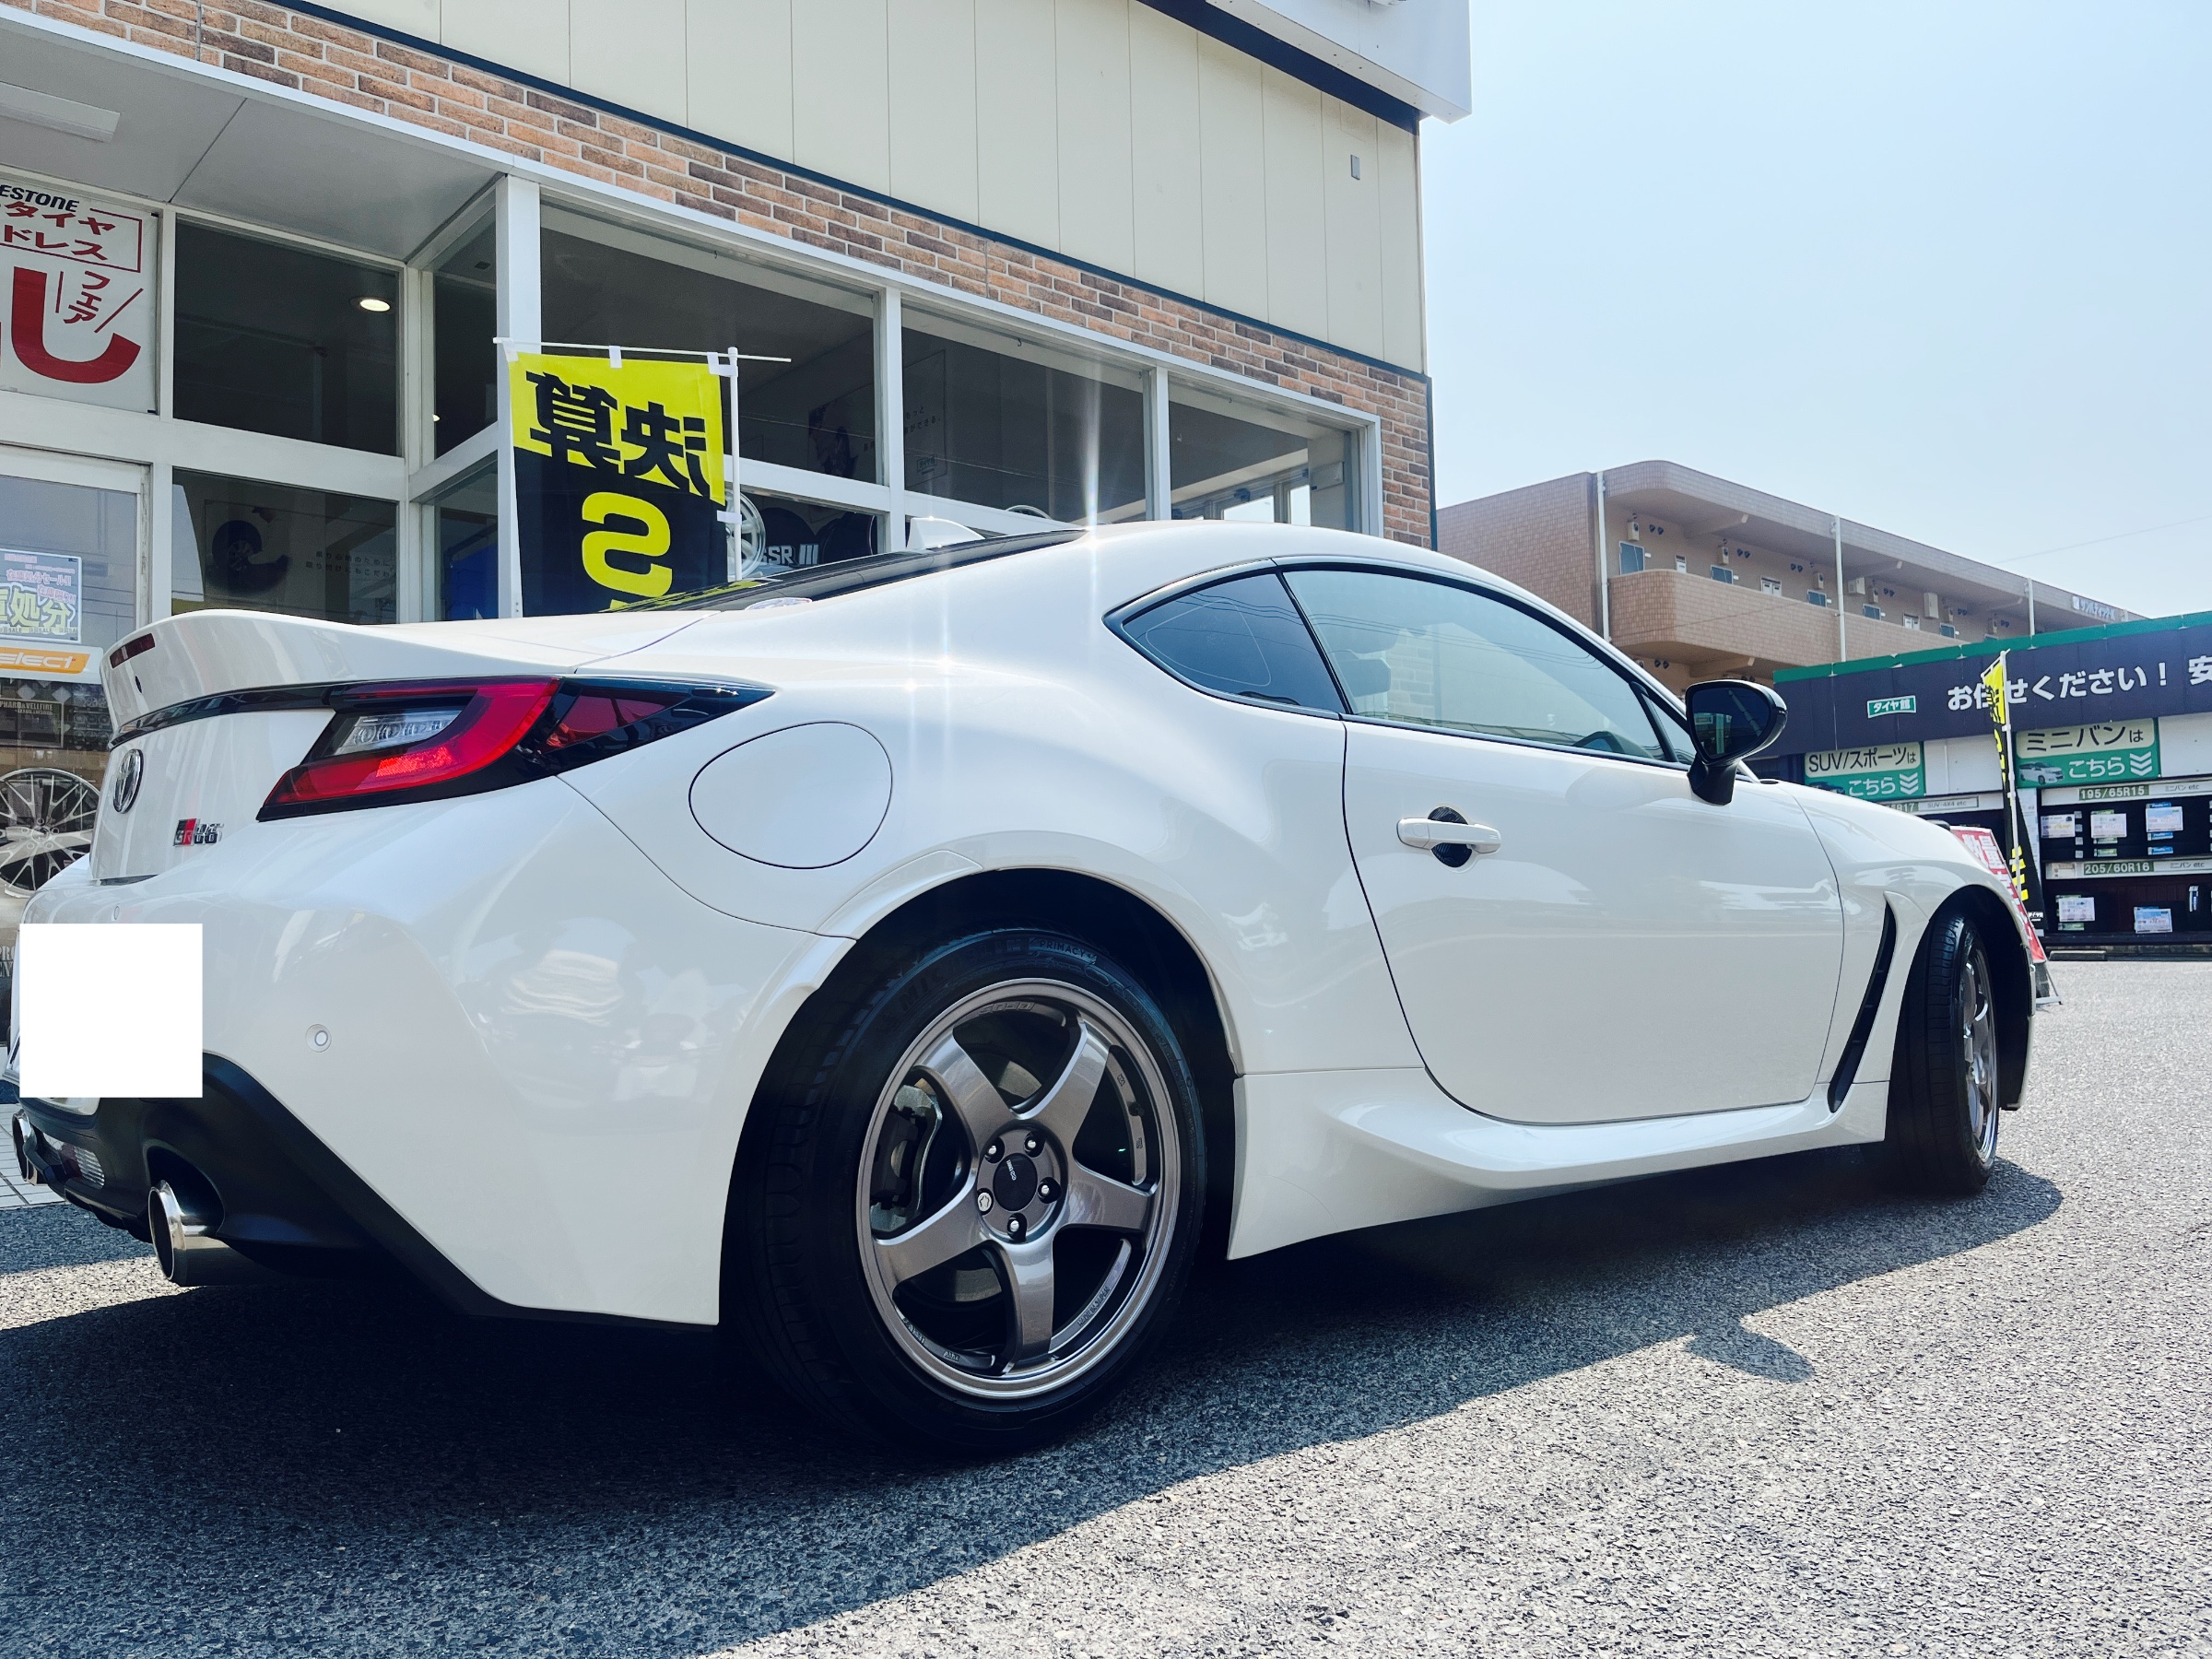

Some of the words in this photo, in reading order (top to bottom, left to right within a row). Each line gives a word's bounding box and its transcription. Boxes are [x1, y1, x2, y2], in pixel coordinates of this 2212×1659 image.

[0, 201, 116, 235] タイヤ
[5, 225, 109, 261] ドレス
[63, 270, 112, 324] フェア
[1873, 698, 1912, 713] タイヤ館
[2027, 724, 2144, 752] ミニバンは
[1808, 747, 1917, 772] SUV/スポーツは
[2068, 756, 2125, 778] こちら
[1848, 776, 1897, 797] こちら
[2080, 786, 2146, 800] 195/65R15
[2084, 862, 2151, 875] 205/60R16
